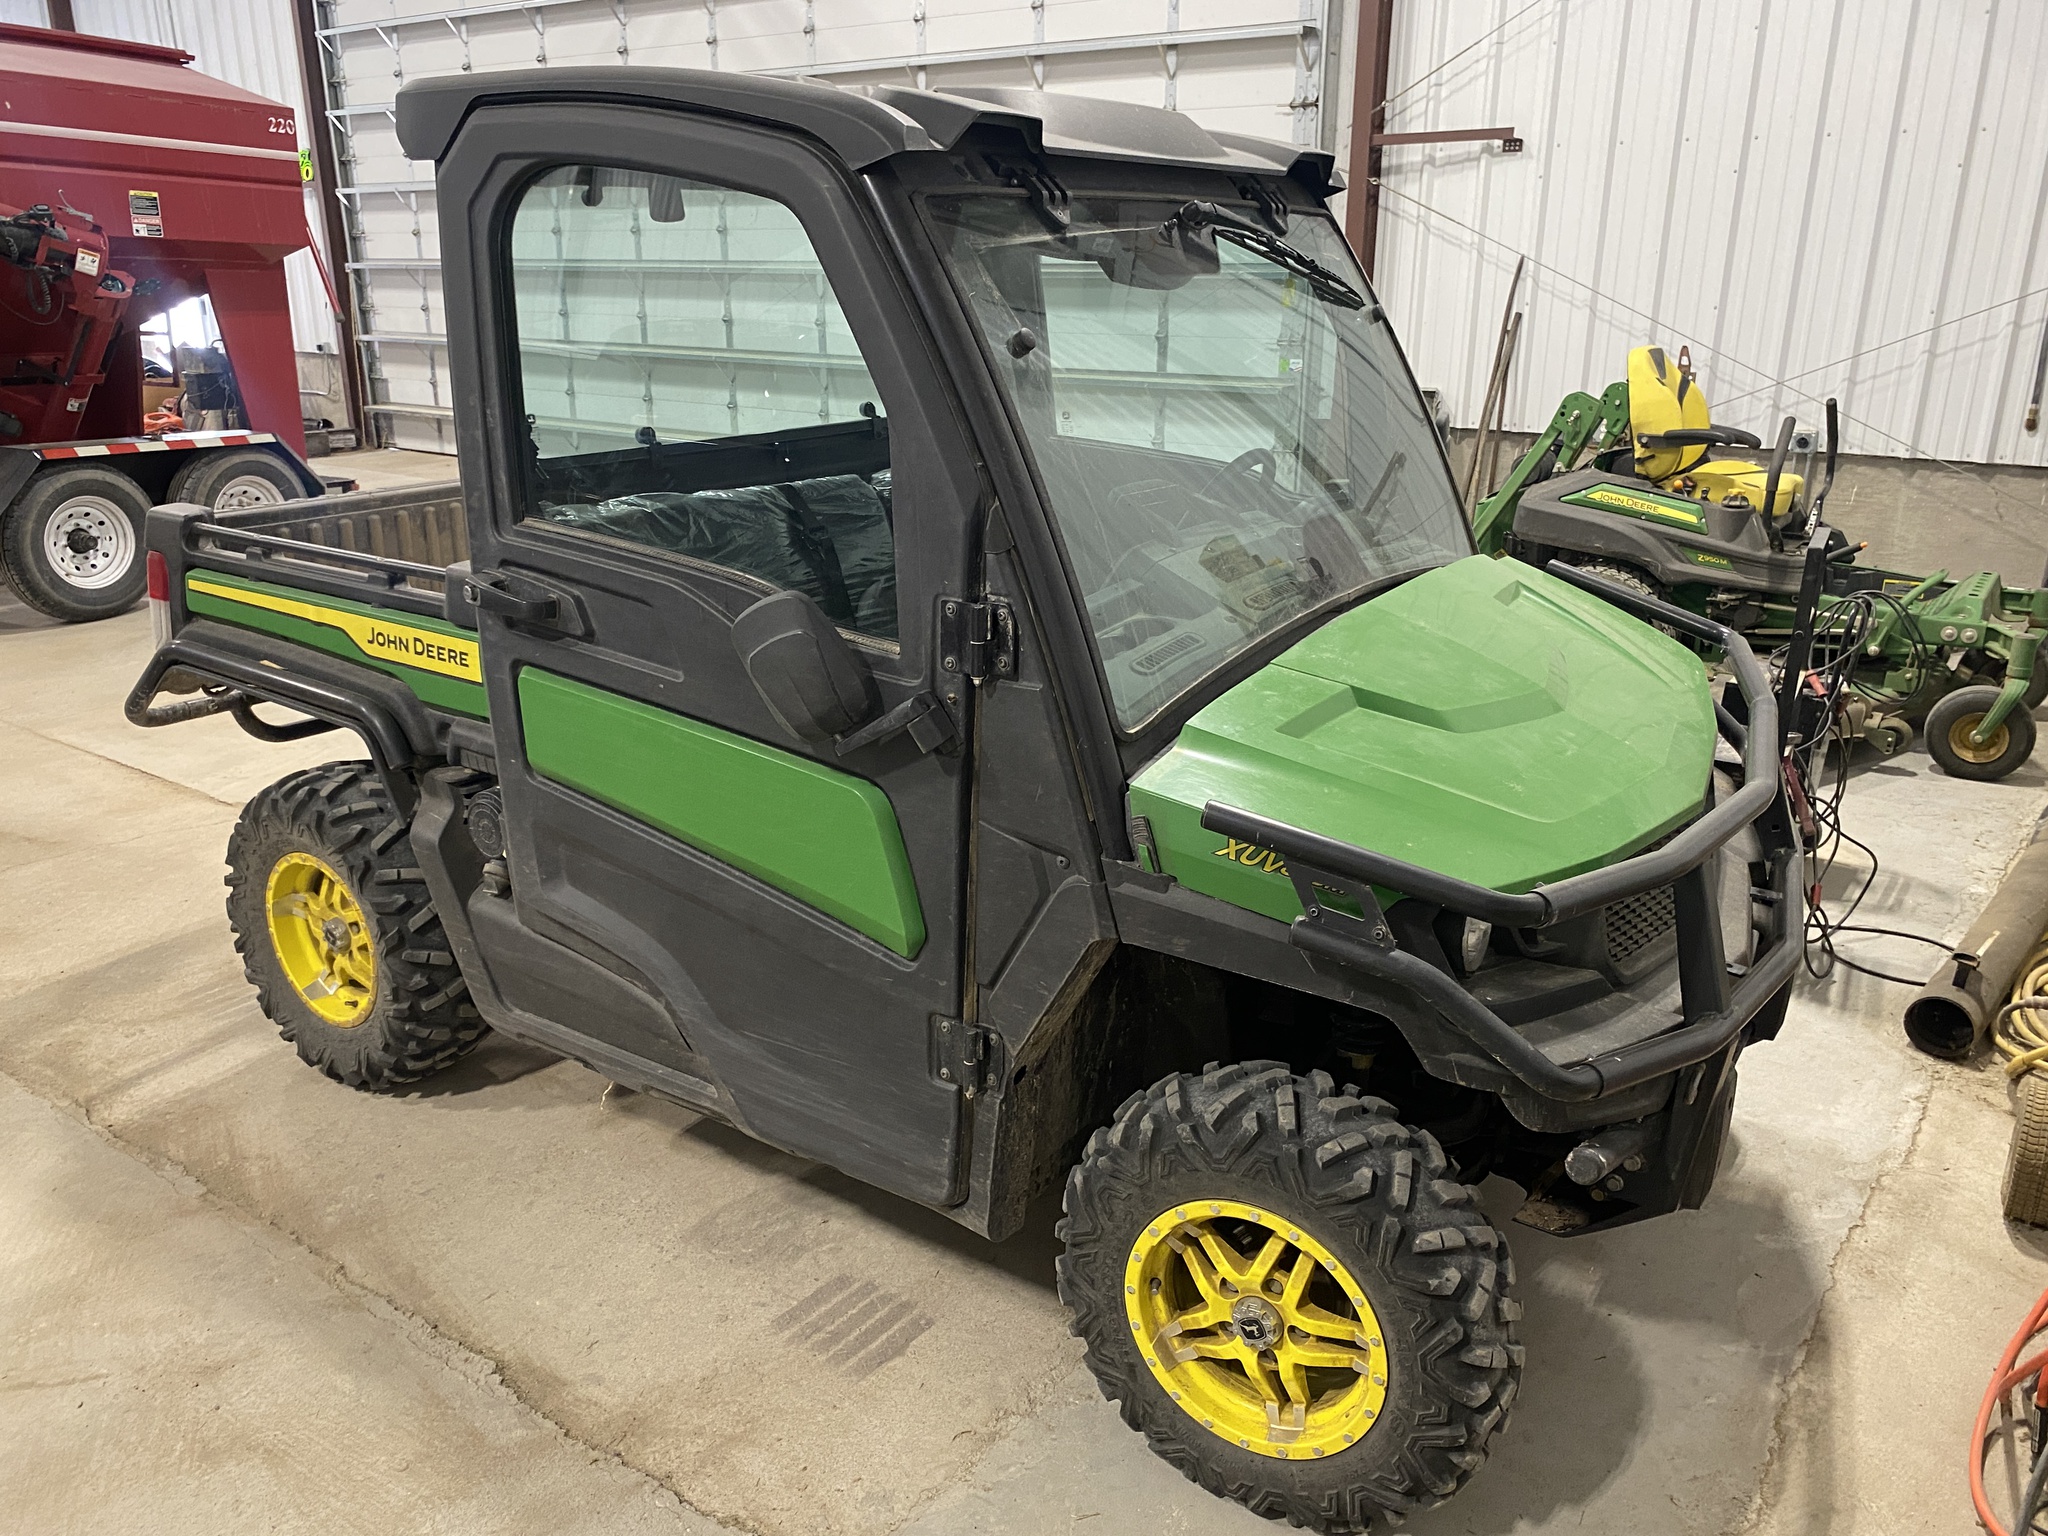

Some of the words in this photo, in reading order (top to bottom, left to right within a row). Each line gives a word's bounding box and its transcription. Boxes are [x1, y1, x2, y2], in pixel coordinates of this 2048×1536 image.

[268, 117, 295, 135] 220
[1598, 493, 1624, 504] JOHN
[1626, 498, 1659, 513] DEERE
[367, 627, 409, 653] JOHN
[413, 636, 469, 668] DEERE
